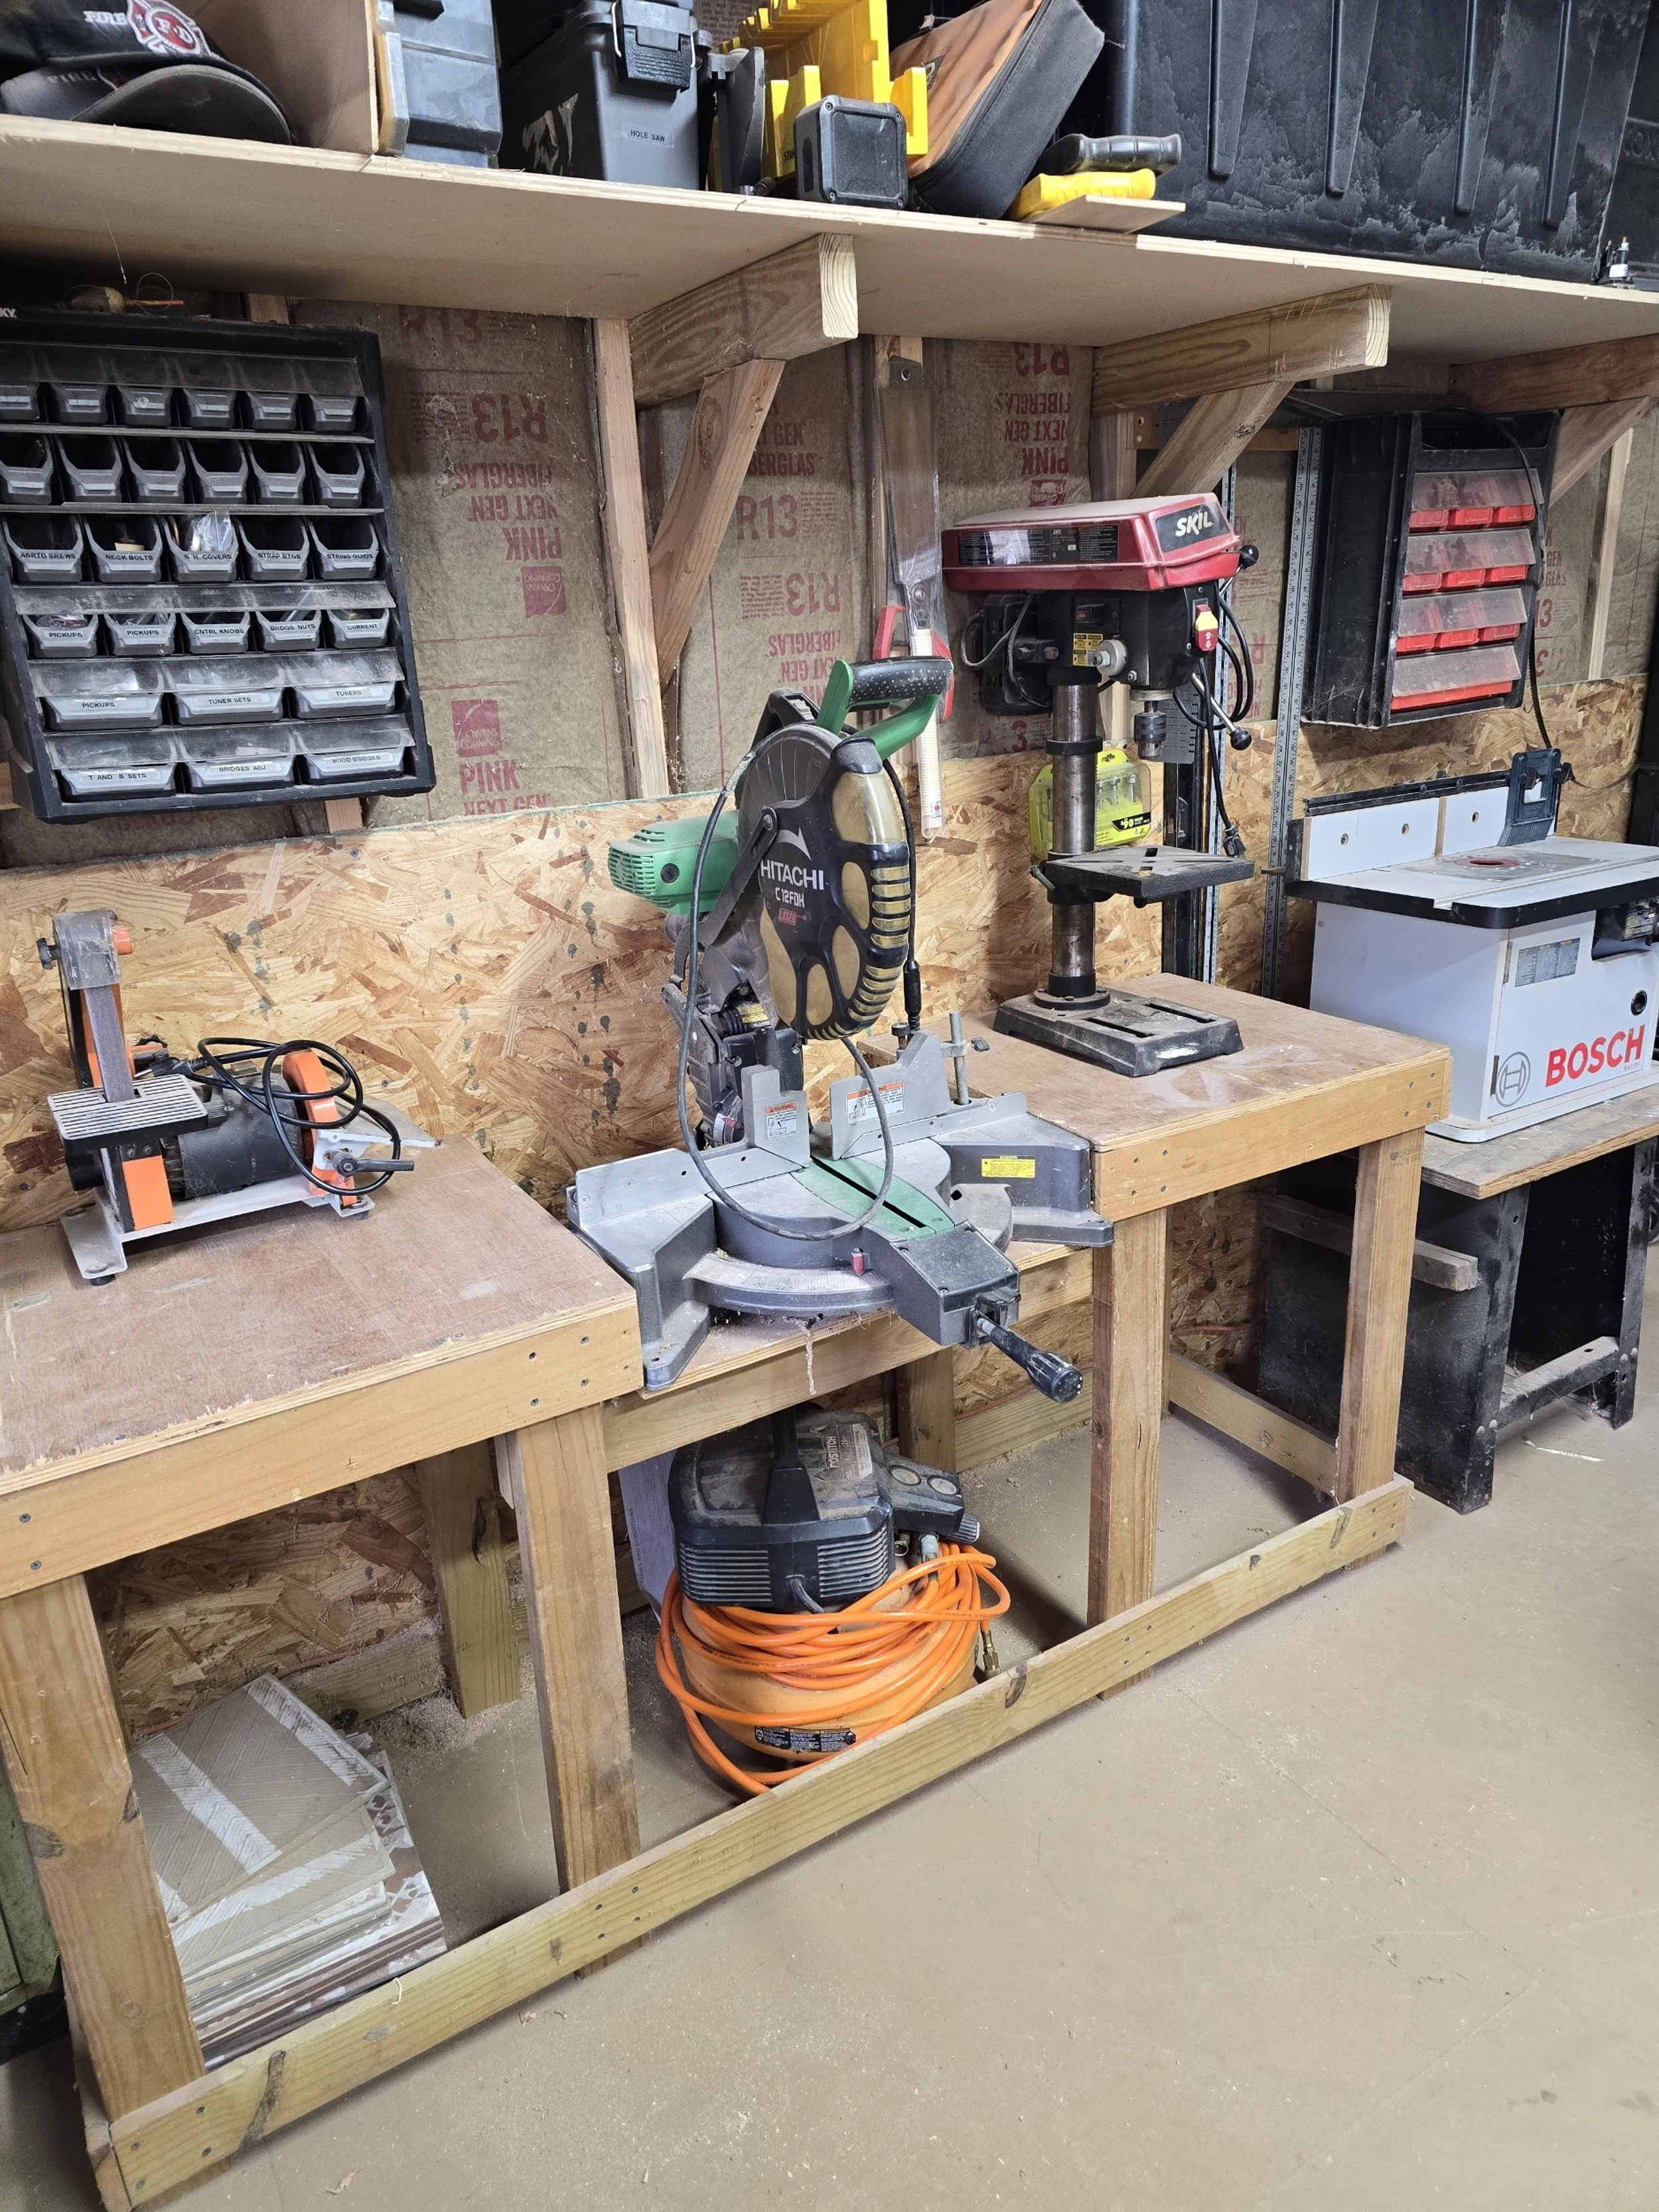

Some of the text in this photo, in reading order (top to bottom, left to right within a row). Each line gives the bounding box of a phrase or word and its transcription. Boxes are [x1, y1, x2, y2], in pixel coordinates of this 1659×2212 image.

[83, 11, 128, 25] FIRE
[630, 130, 666, 143] HOLE SAW
[471, 392, 548, 443] R13
[1005, 419, 1030, 443] GEN
[772, 422, 804, 447] GEN
[748, 452, 816, 477] BERGLAS
[1021, 447, 1069, 475] PINK
[470, 494, 558, 522] NEXT GEN
[735, 494, 800, 541] R13
[1175, 511, 1212, 537] SKIL
[501, 527, 563, 561] PINK
[524, 573, 561, 583] CORNING
[526, 583, 556, 592] OWENS
[786, 571, 841, 617] R13
[1535, 598, 1553, 628] 13
[780, 659, 809, 684] GEN
[465, 728, 498, 739] OWENS
[459, 759, 521, 796] PINK
[513, 794, 547, 810] GEN
[760, 859, 825, 891] HITACHI
[1545, 1024, 1646, 1088] BOSCH
[628, 1507, 640, 1548] CONDITIONS
